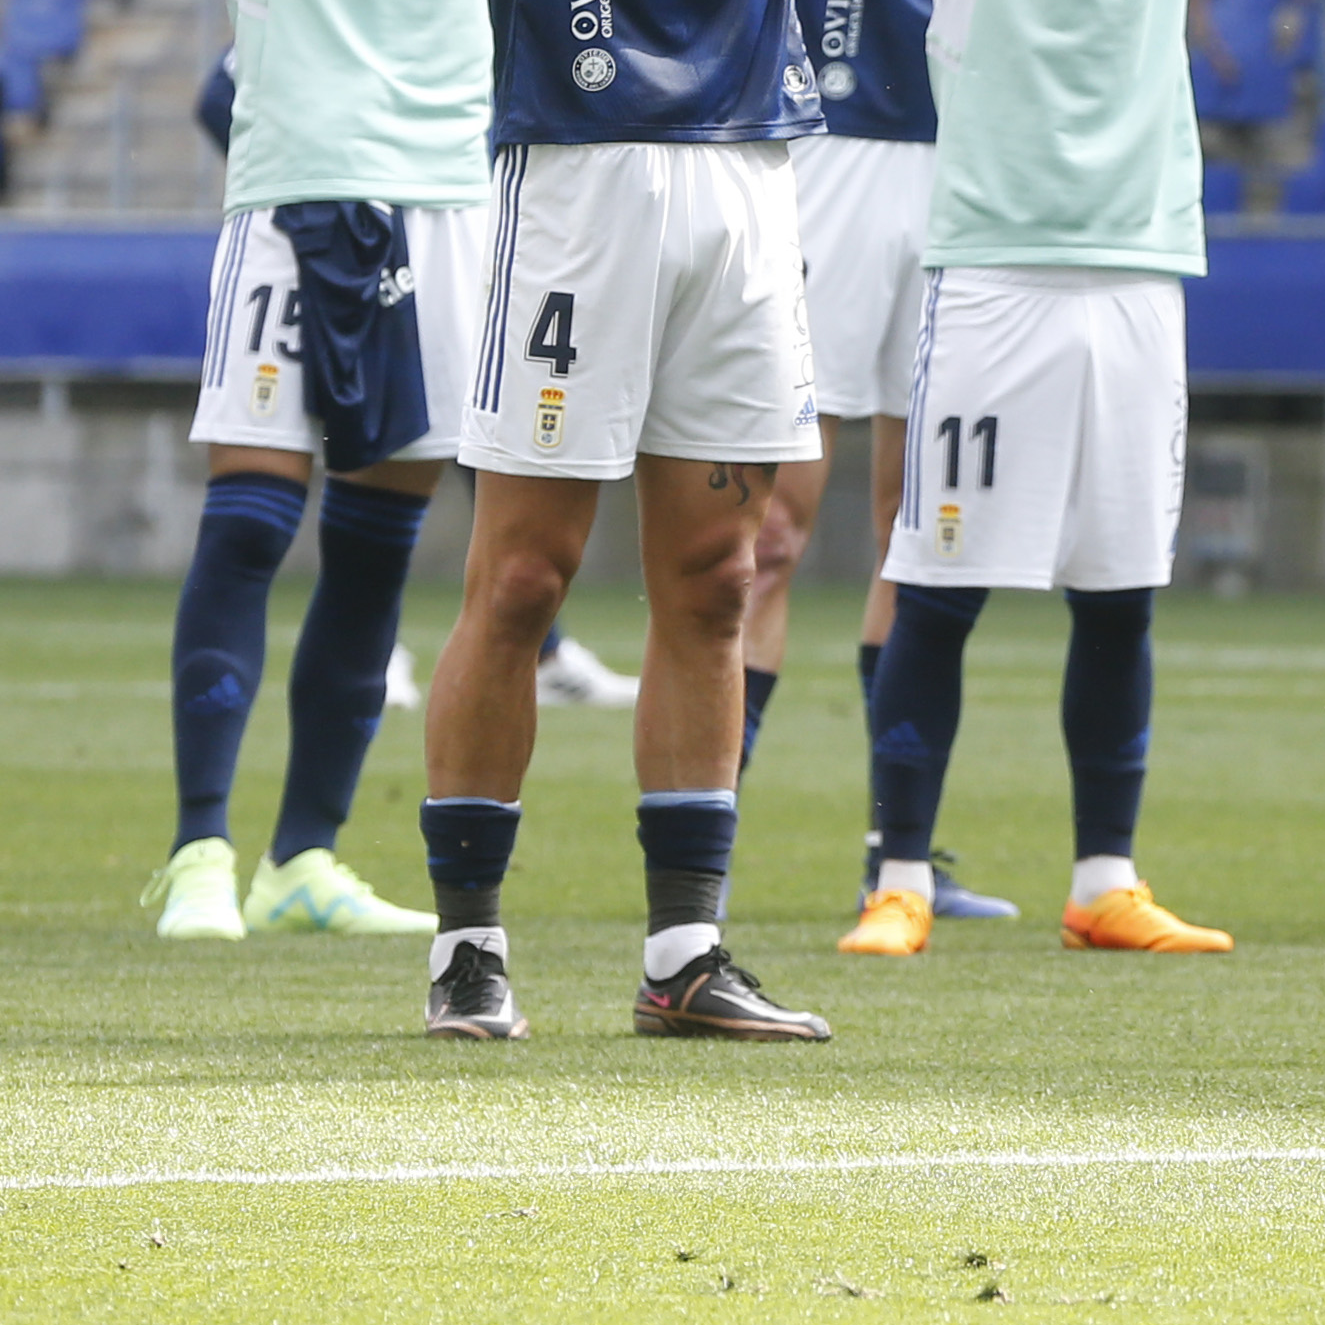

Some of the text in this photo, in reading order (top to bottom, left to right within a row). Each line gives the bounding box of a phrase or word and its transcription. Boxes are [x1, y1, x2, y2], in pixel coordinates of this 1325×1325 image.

[246, 284, 302, 364] 15
[524, 291, 577, 378] 4
[934, 416, 998, 491] 11
